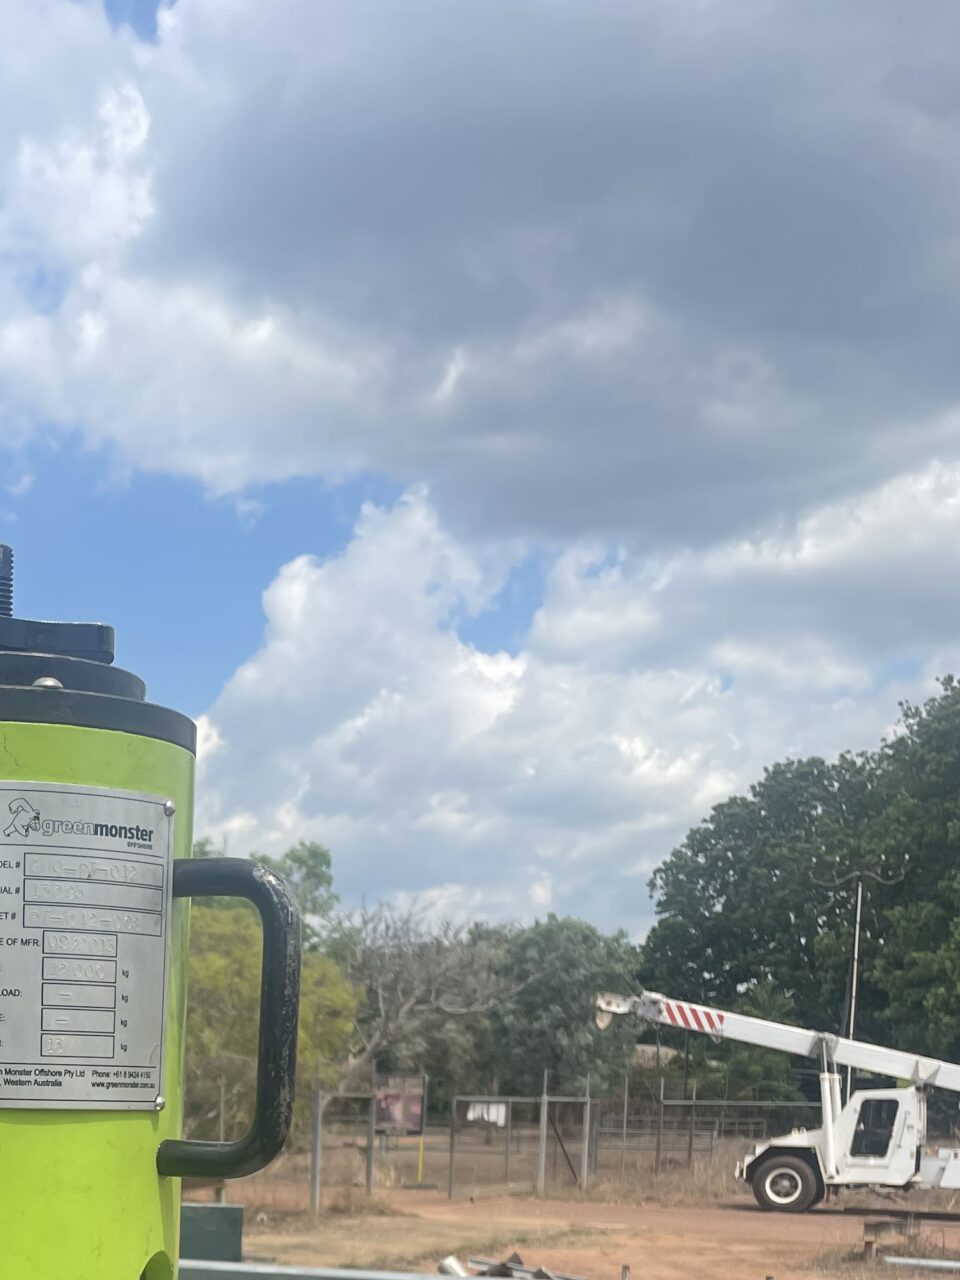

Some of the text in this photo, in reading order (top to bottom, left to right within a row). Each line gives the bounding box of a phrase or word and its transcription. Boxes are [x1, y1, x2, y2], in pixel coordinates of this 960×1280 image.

[127, 841, 153, 850] OFFSHORE
[15, 861, 21, 869] #
[14, 886, 21, 895] #
[10, 912, 17, 921] #
[6, 938, 19, 946] OF
[20, 938, 40, 947] MFR:
[122, 969, 130, 978] kg
[121, 993, 129, 1003] kg
[120, 1018, 128, 1028] kg
[120, 1043, 128, 1052] kg
[4, 1068, 33, 1077] Monster
[34, 1068, 62, 1078] Offshore
[63, 1069, 74, 1079] Pty
[75, 1070, 86, 1078] Ltd
[91, 1070, 111, 1078] Phone:
[3, 1078, 32, 1087] Western
[33, 1079, 63, 1087] Australia
